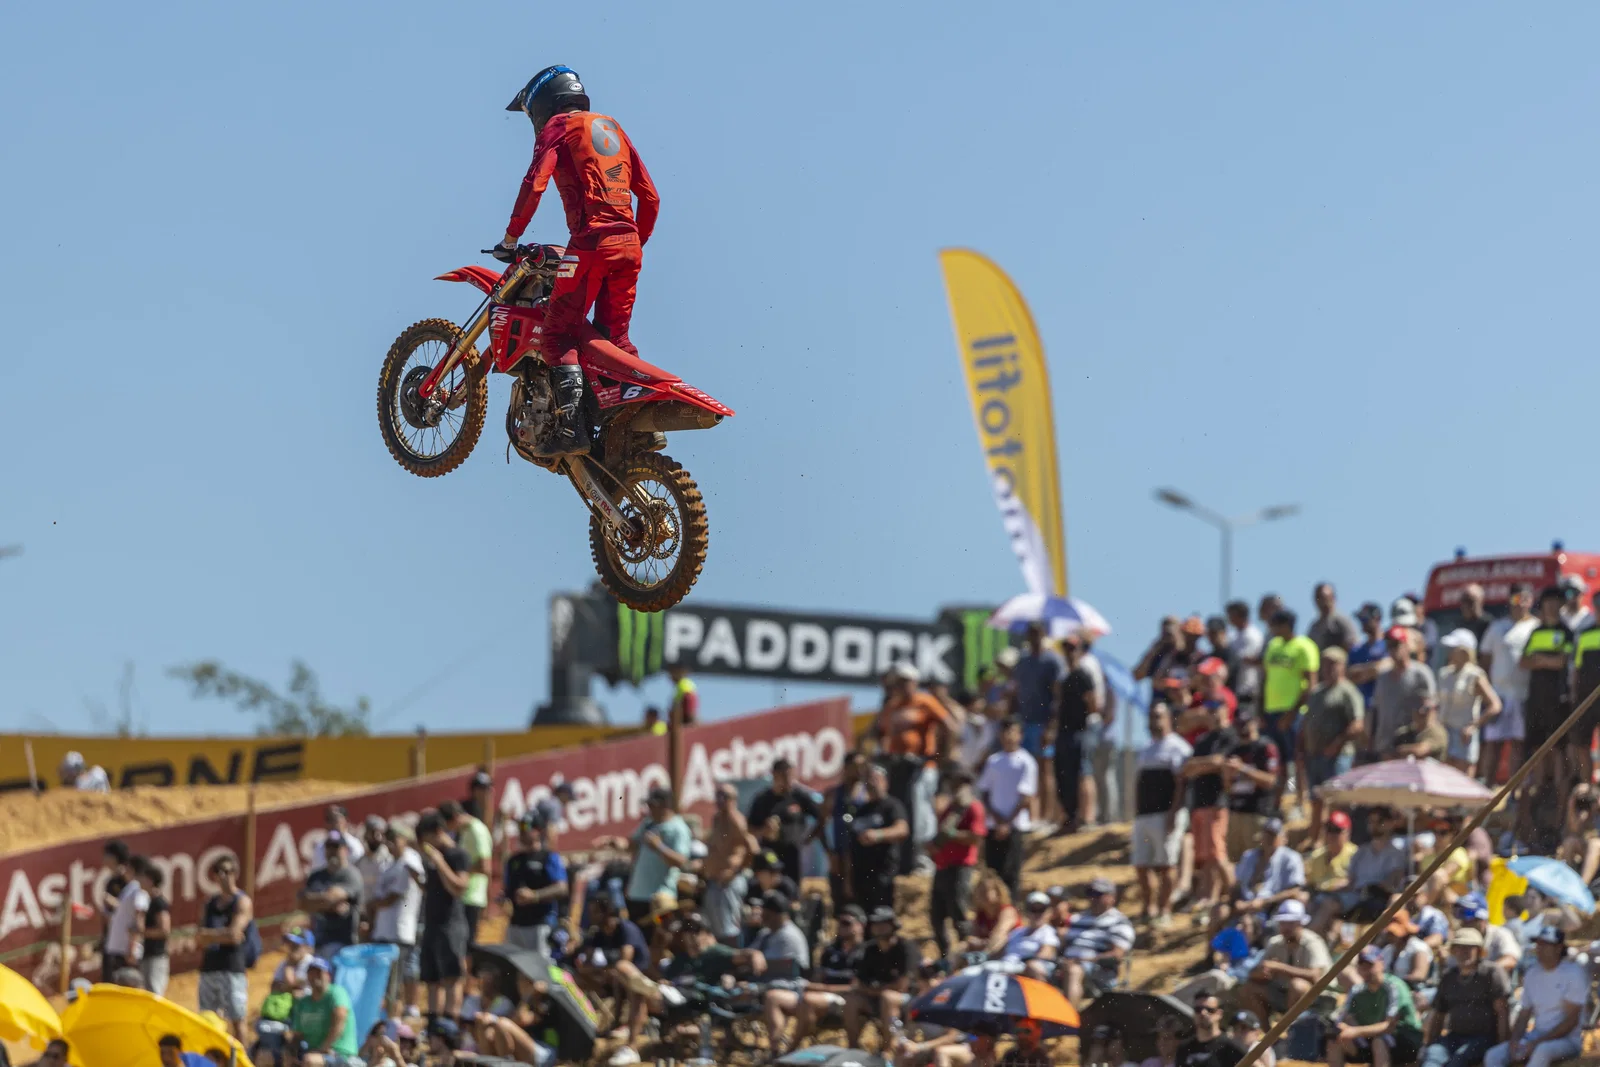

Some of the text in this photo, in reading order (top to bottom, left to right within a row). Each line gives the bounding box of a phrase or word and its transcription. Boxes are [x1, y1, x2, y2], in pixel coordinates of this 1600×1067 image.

[592, 118, 620, 156] 6
[622, 385, 643, 400] 6
[664, 613, 956, 684] PADDOCK
[0, 846, 241, 940] Astmo
